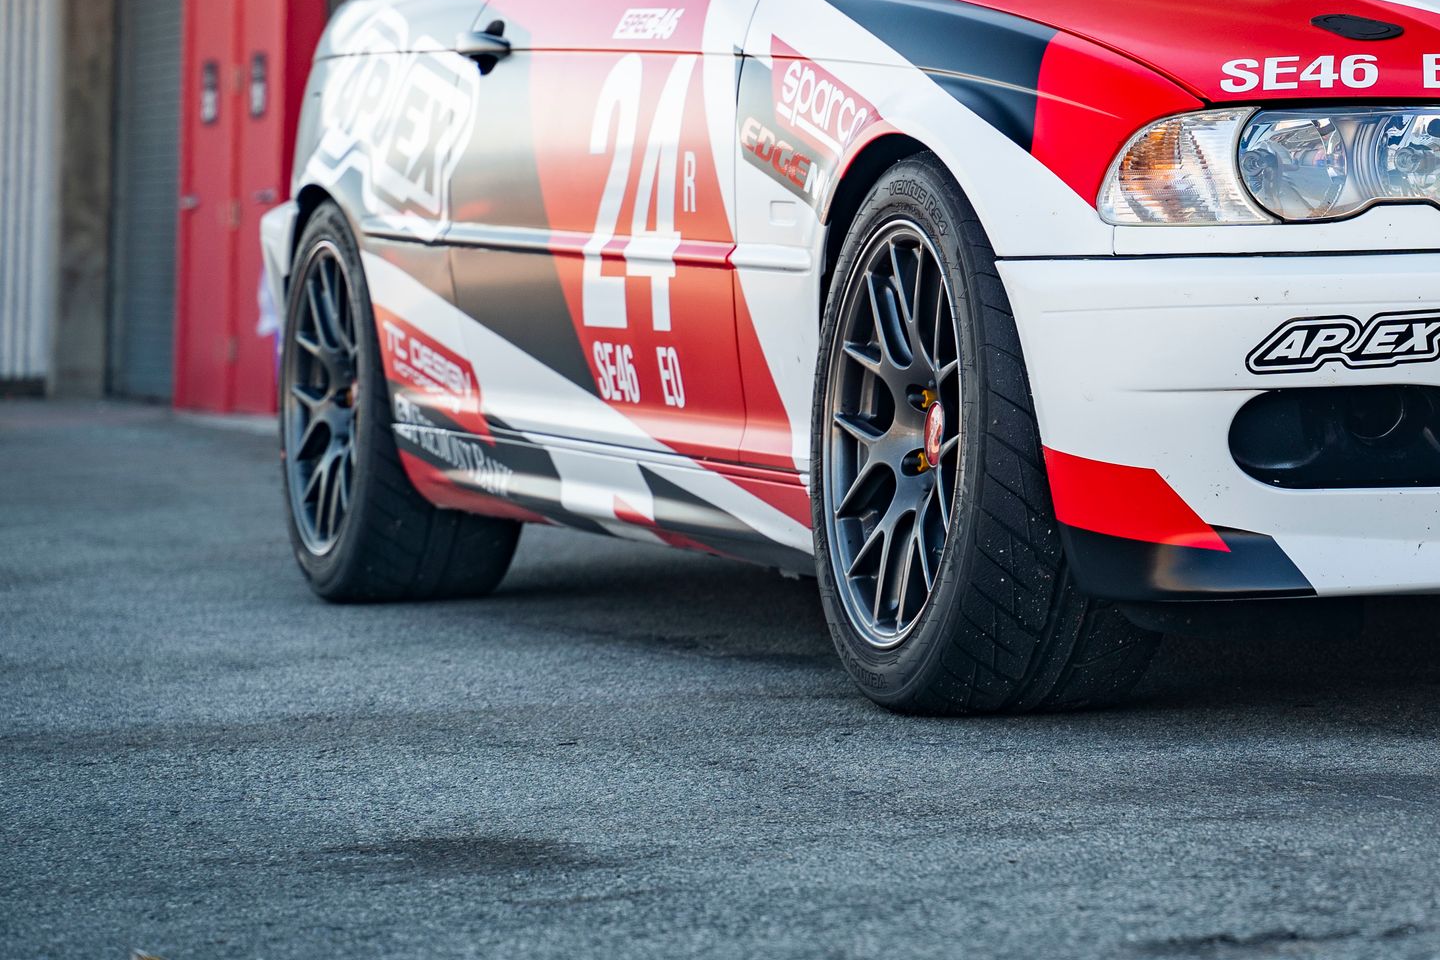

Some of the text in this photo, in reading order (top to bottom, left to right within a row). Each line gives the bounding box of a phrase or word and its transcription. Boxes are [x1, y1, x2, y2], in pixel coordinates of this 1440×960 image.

[1220, 54, 1379, 92] SE46
[582, 52, 698, 332] 24
[593, 341, 641, 404] SE46
